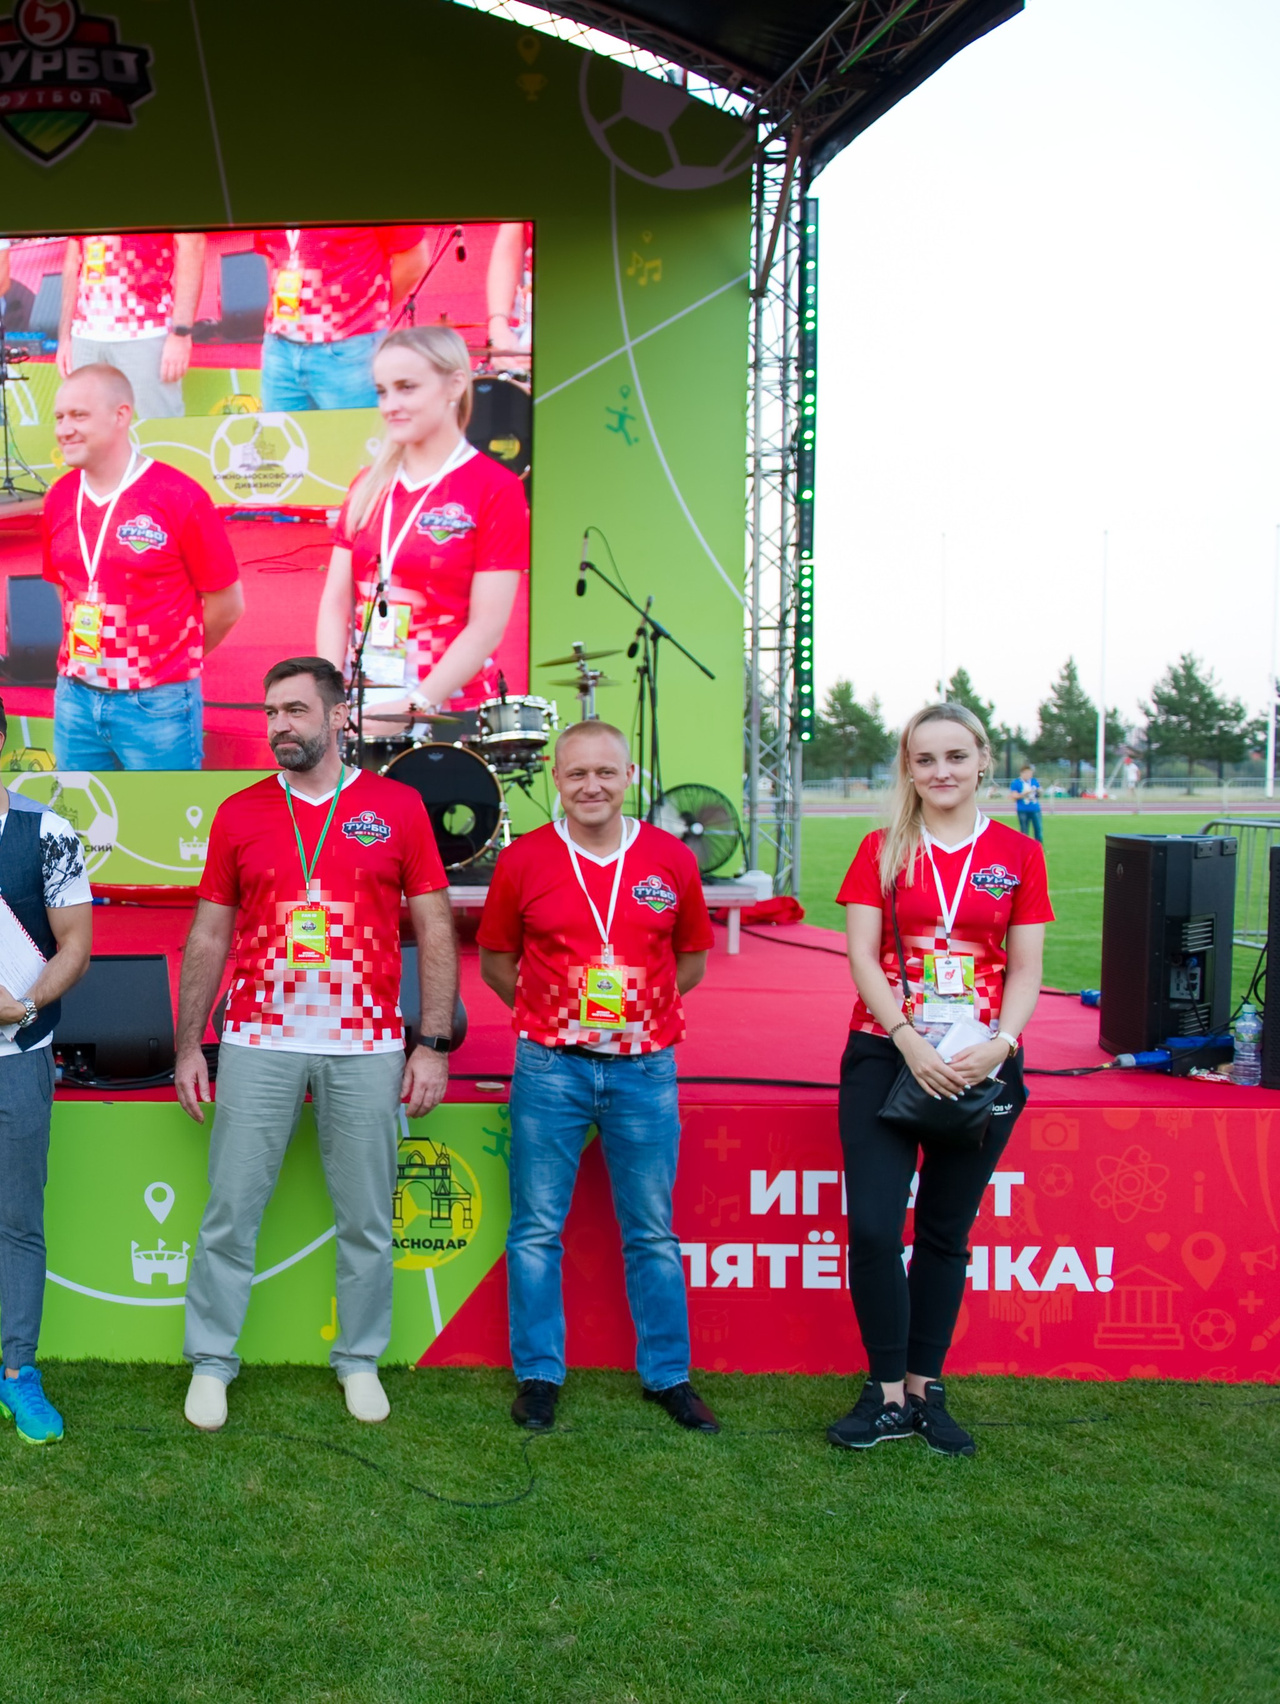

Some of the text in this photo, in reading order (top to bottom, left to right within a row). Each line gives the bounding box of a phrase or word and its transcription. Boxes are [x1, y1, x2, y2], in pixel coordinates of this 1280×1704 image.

[84, 843, 113, 852] СКИЙ
[392, 1237, 468, 1251] АСНОДАР
[680, 1230, 1115, 1293] ПЯТЁКА!
